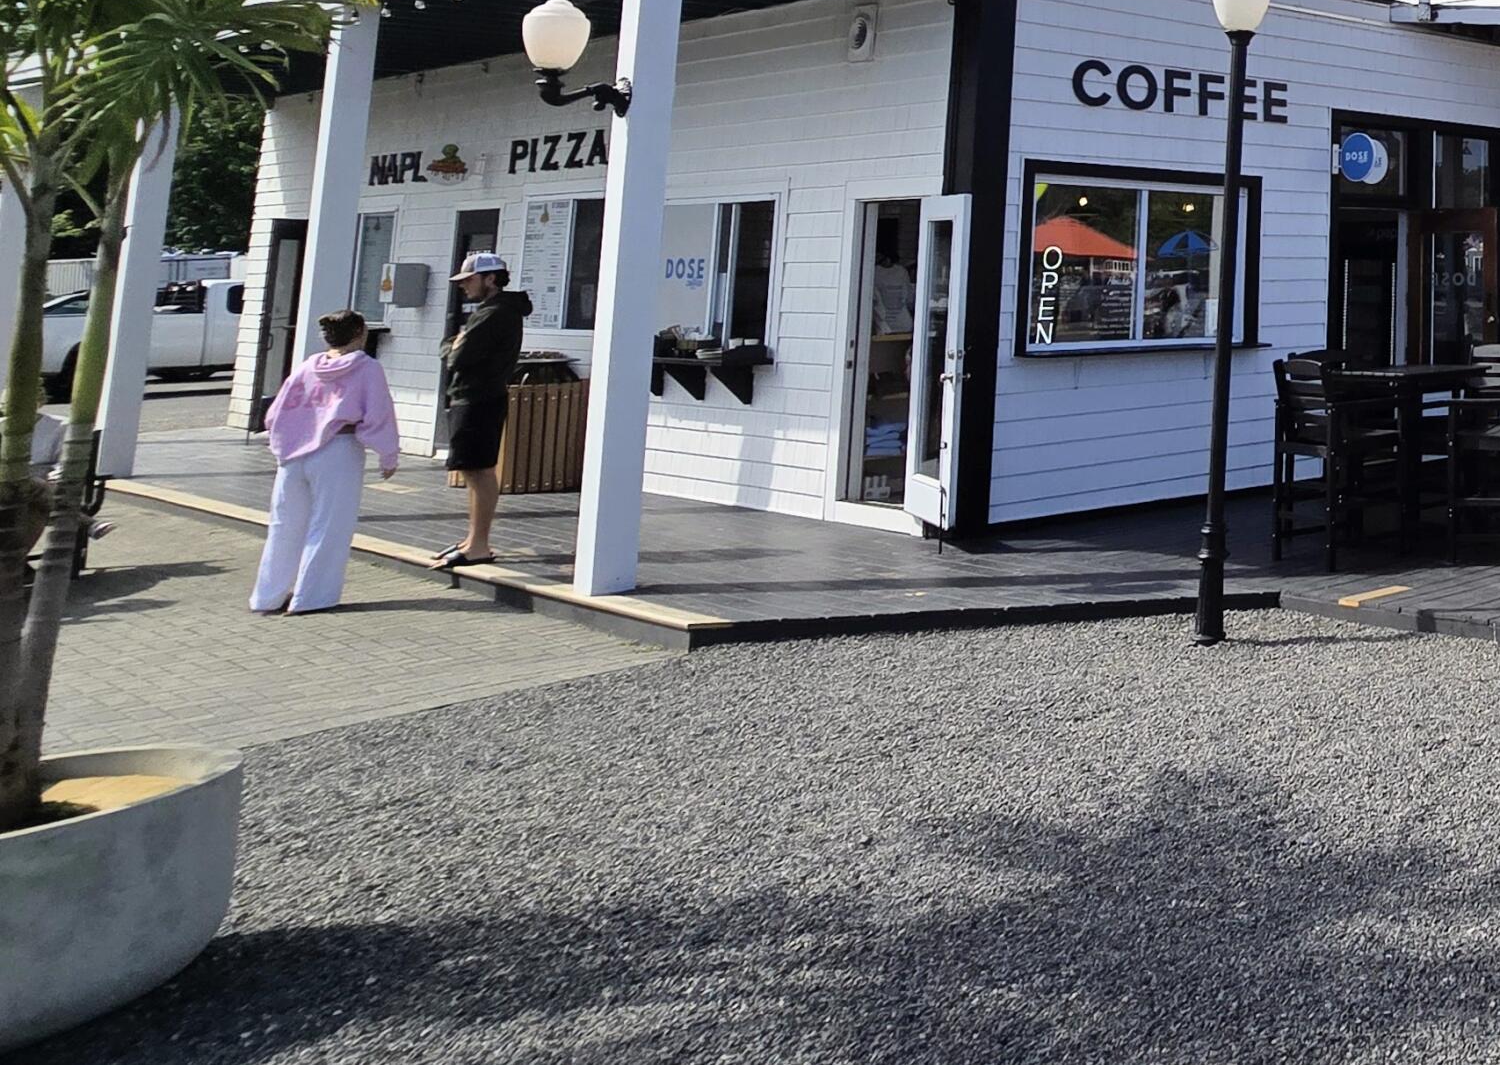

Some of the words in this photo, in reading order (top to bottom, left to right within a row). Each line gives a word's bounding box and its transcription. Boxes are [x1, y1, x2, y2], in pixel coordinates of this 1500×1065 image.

[1072, 59, 1288, 124] COFFEE
[508, 129, 608, 175] PIZZA
[1345, 151, 1368, 161] DOSE
[665, 257, 705, 279] DOSE
[1034, 246, 1063, 344] OPEN
